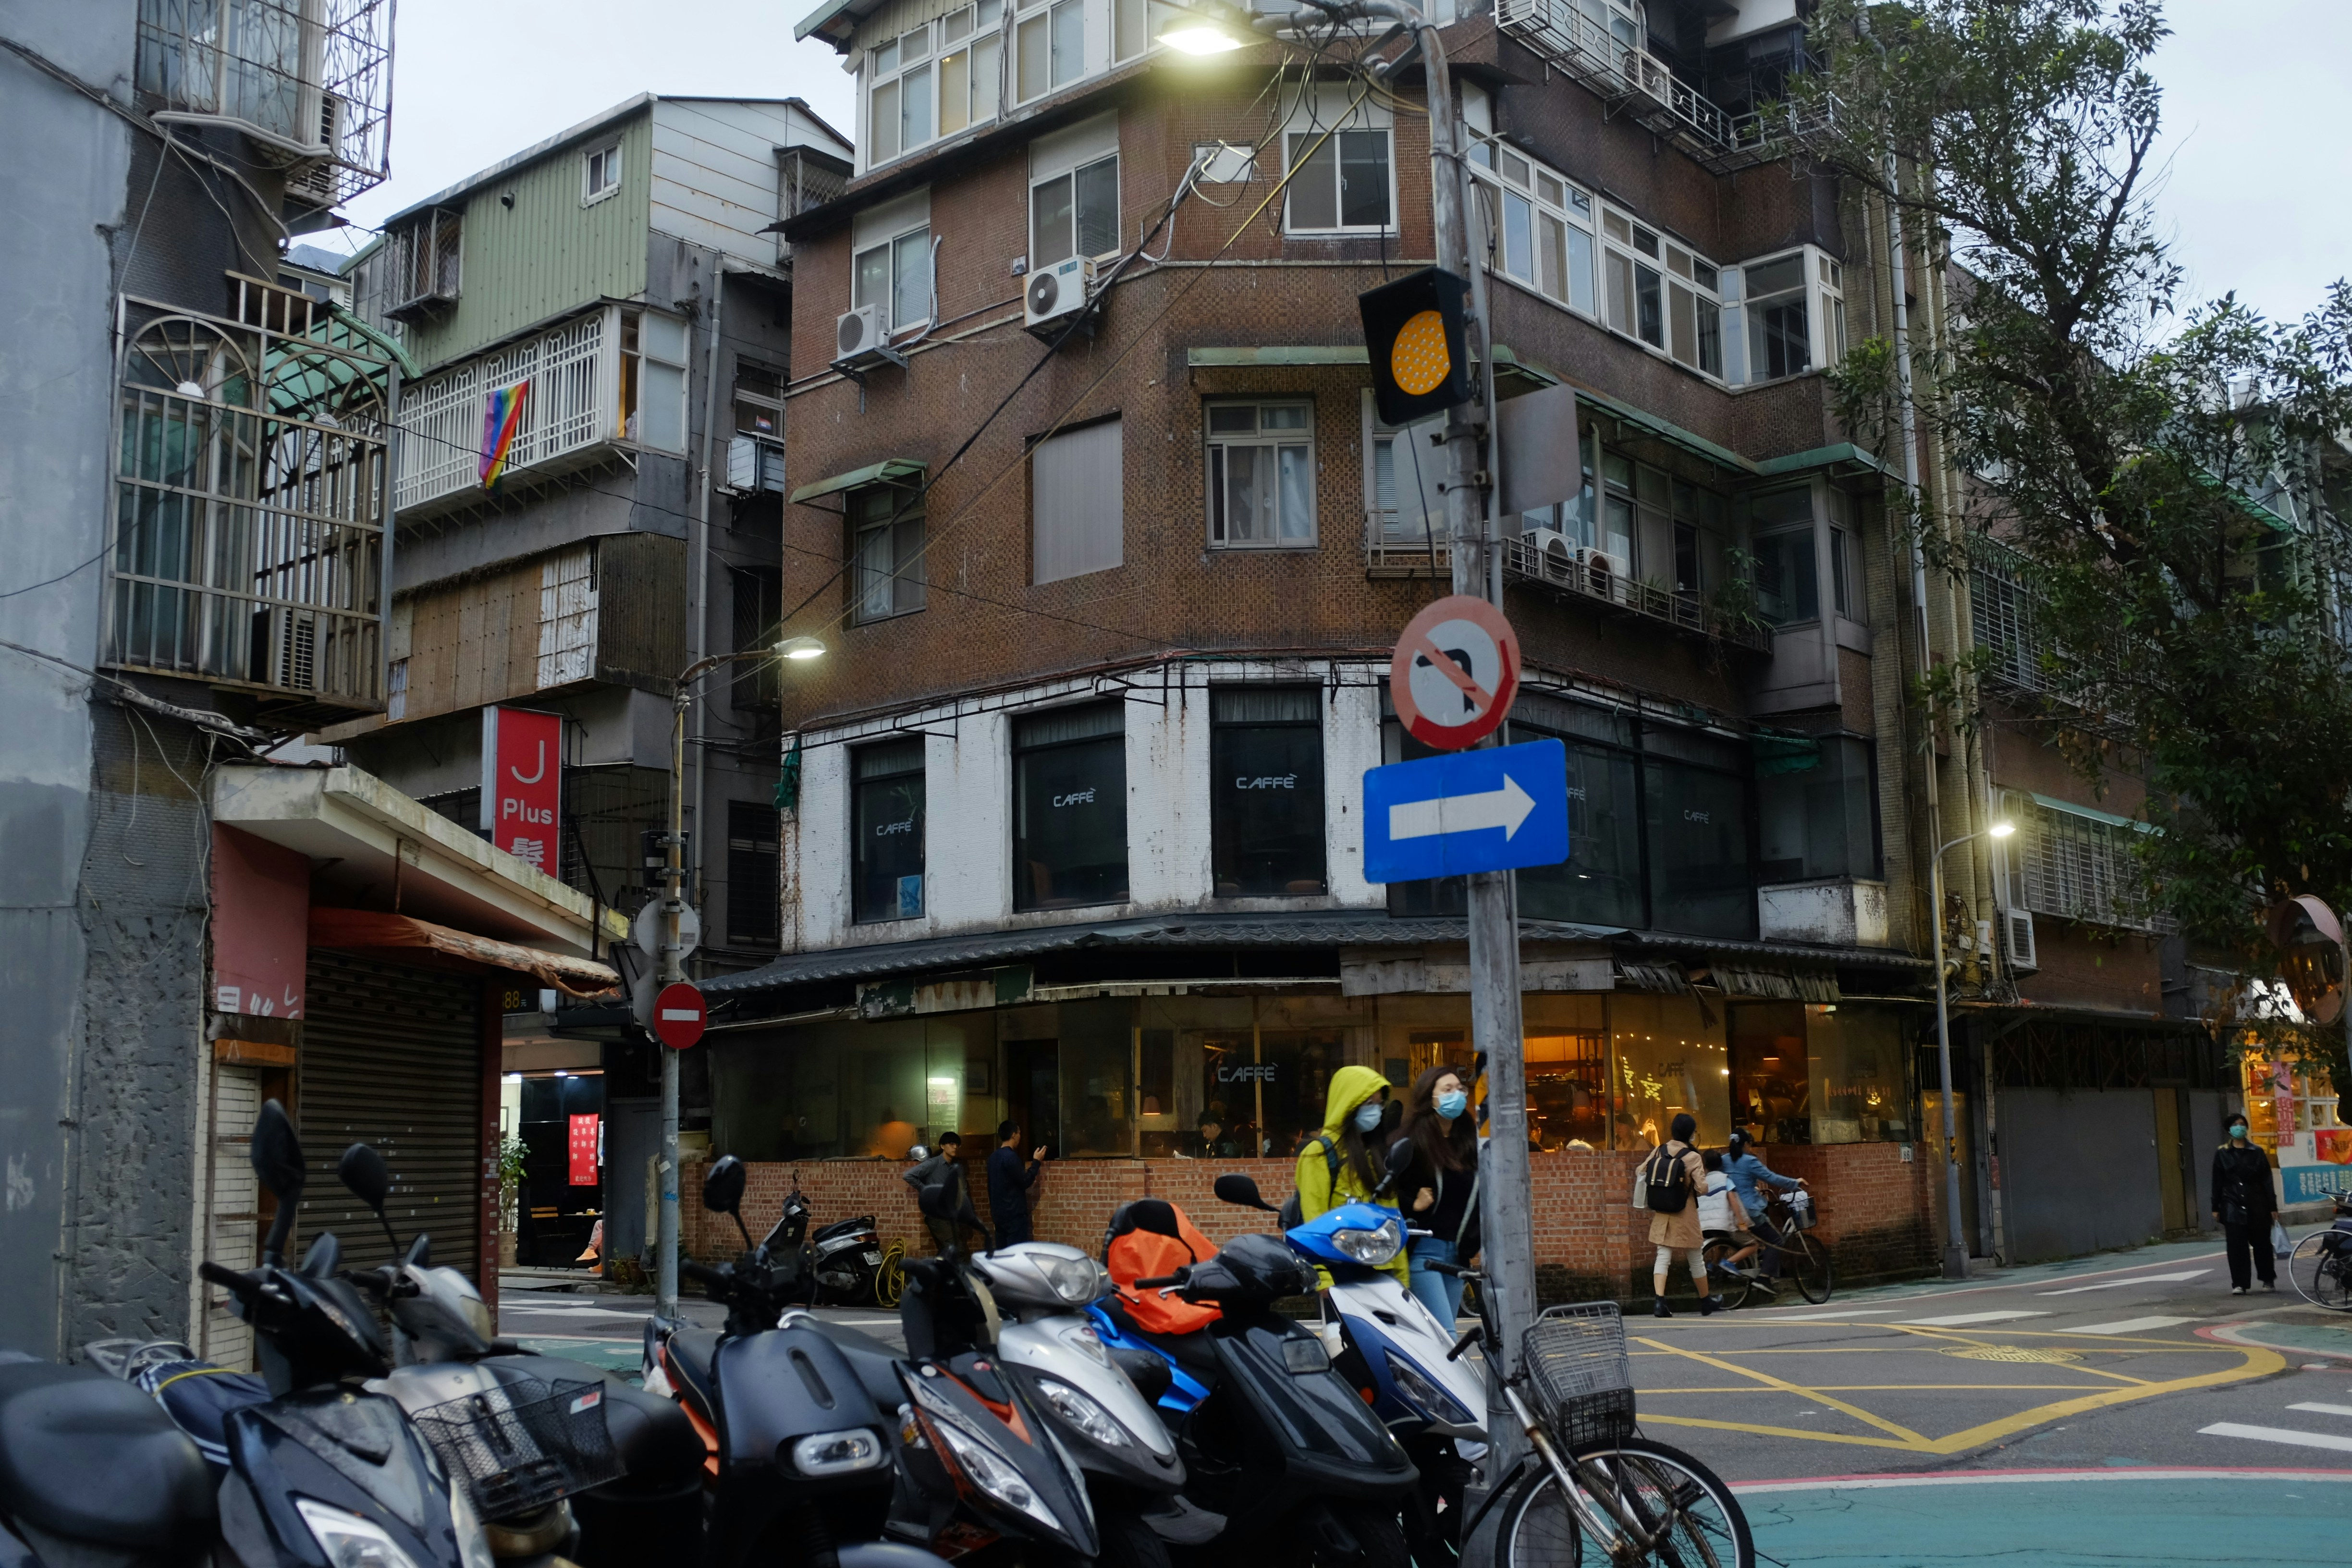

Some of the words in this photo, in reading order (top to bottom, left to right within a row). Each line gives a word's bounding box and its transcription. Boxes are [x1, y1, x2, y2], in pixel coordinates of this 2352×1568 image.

[511, 740, 544, 784] J
[1236, 773, 1298, 789] CAFFÈ
[1053, 787, 1096, 807] CAFFÈ
[503, 798, 552, 824] Plus
[1684, 809, 1710, 824] CAFFÈ
[876, 818, 913, 836] CAFFÈ
[1218, 1062, 1278, 1083] CAFFÈ
